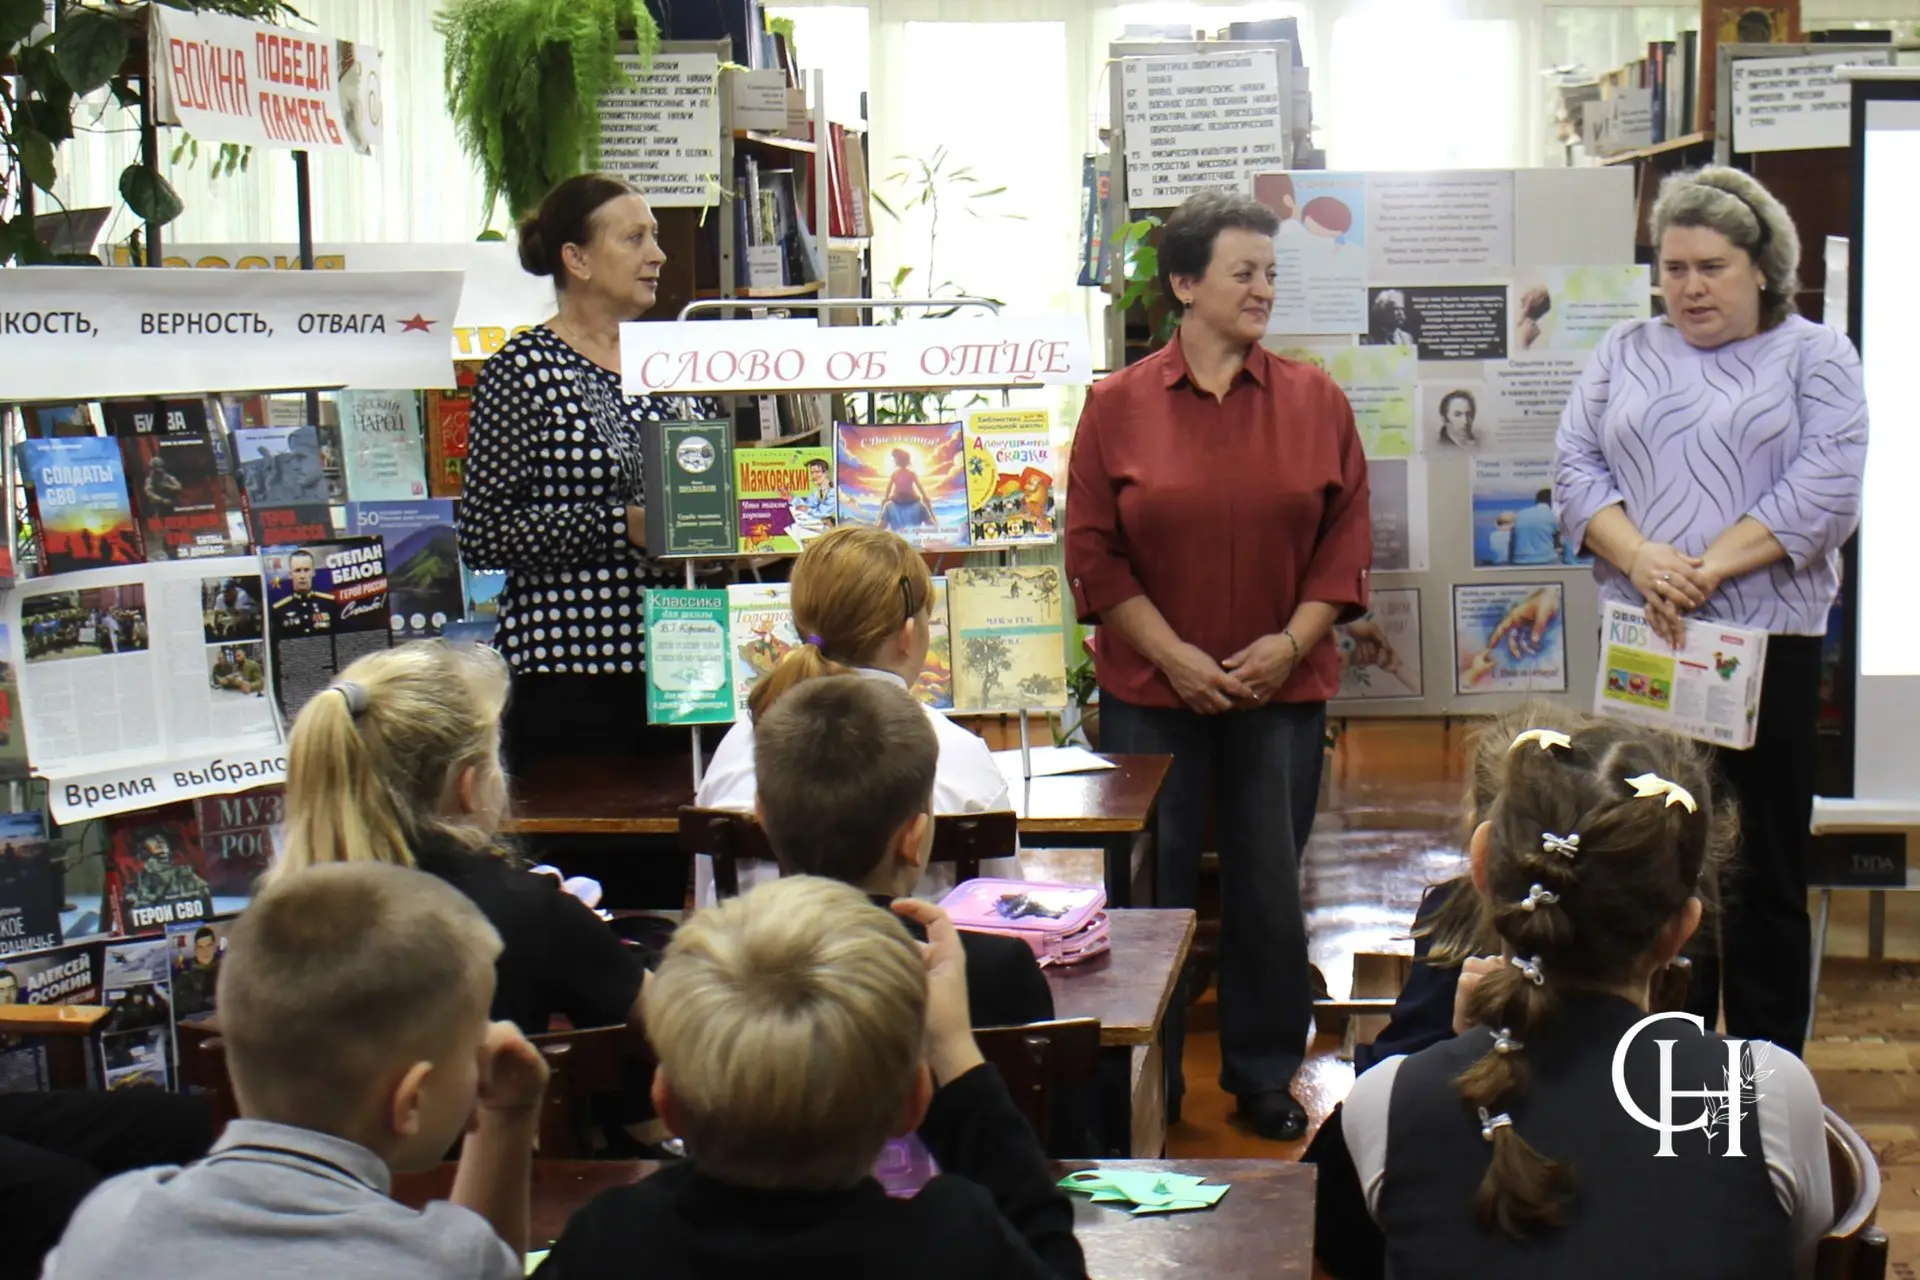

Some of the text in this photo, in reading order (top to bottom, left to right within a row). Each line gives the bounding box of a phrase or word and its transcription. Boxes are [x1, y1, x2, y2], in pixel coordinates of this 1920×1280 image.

[255, 32, 332, 91] ПОБЕДА
[169, 38, 252, 117] ВОЙНА
[259, 92, 344, 145] ПАМЯТЬ
[140, 312, 275, 339] ВЕРНОСТЬ,
[297, 312, 386, 335] ОТВАГА
[640, 338, 1071, 389] СЛОВО ОБ ОТЦЕ
[352, 414, 406, 433] НАРОД
[42, 464, 114, 486] СОЛДАТЫ
[46, 487, 76, 506] СВО
[357, 511, 380, 527] 50
[326, 544, 383, 569] СТЕПАН
[331, 561, 383, 585] БЕЛОВ
[651, 594, 722, 608] Классика
[735, 607, 794, 624] Толсто
[1610, 621, 1648, 646] KIDS
[64, 777, 156, 808] Время
[215, 795, 282, 828] МУЗ
[220, 832, 266, 860] РОС
[0, 916, 26, 938] КОЕ
[132, 900, 204, 928] ГЕРОИ СВО
[27, 952, 91, 992] АЛЕКСЕЙ
[28, 970, 92, 1005] ОСОКИН
